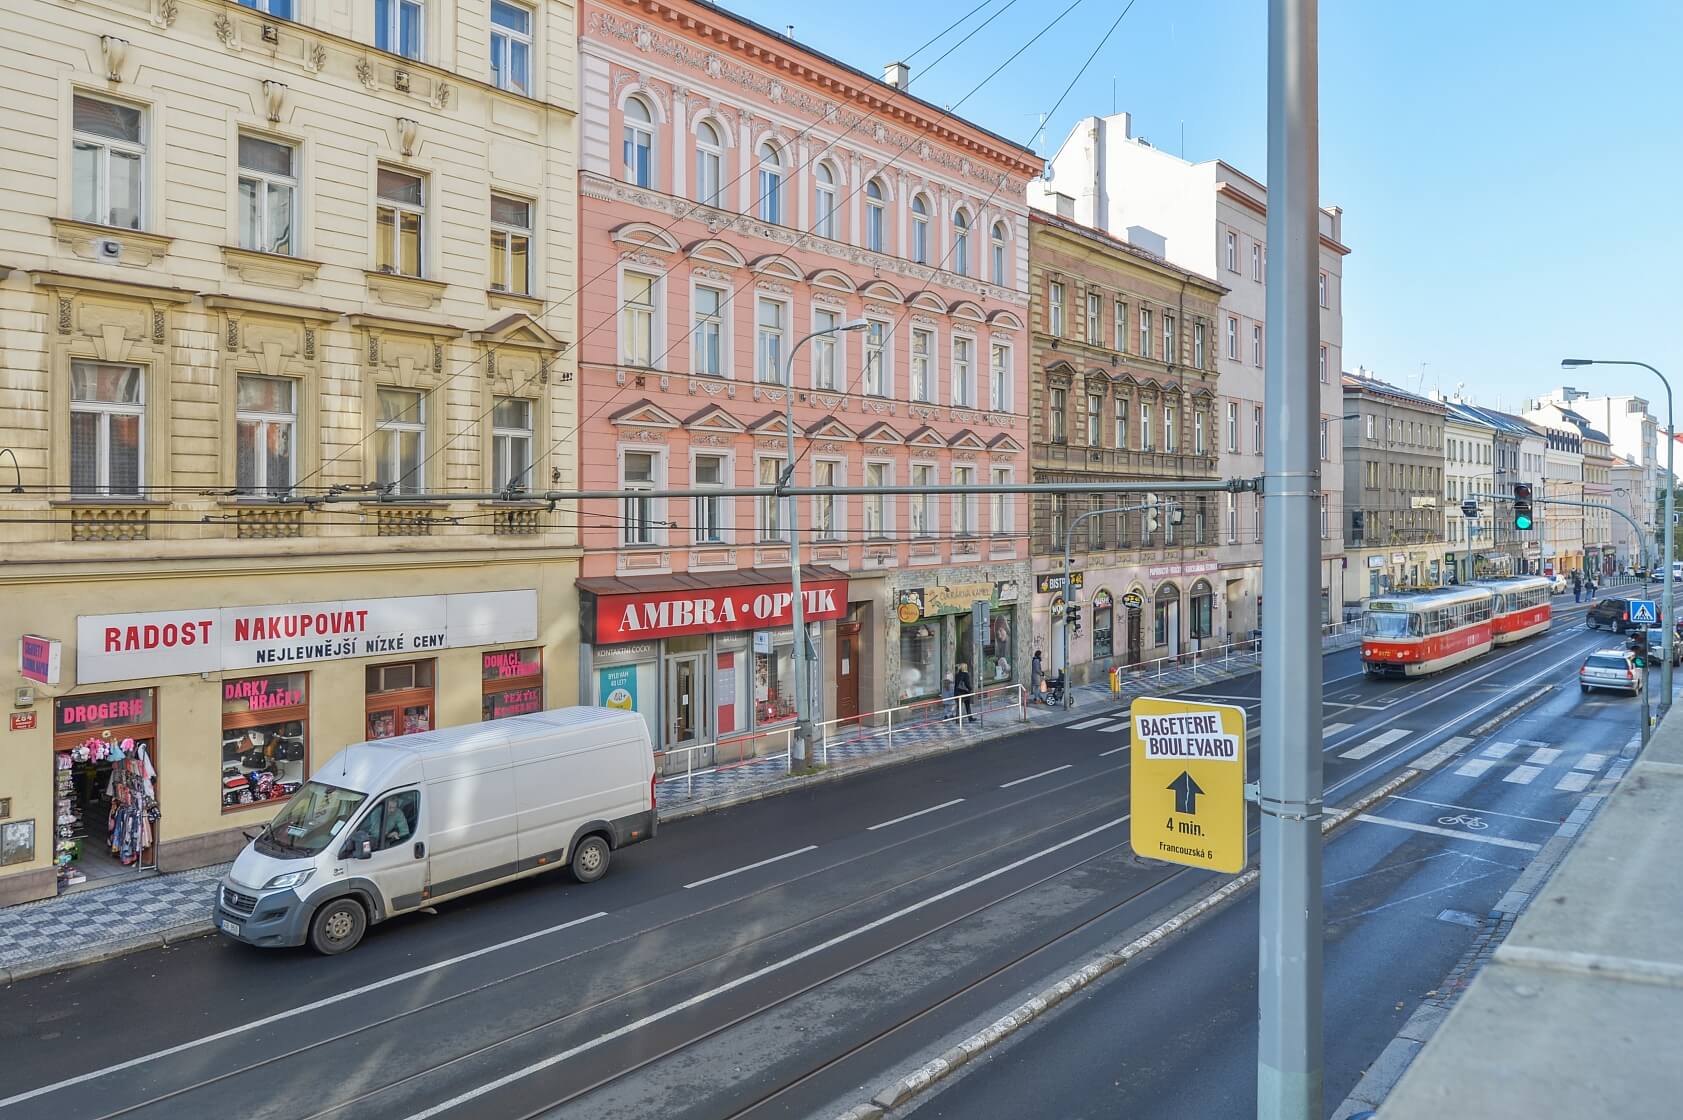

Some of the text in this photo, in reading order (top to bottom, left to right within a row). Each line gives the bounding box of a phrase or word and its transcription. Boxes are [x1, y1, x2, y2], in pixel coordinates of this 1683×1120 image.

[617, 597, 737, 632] AMBRA
[104, 610, 369, 652] RADOST NAKUPOVAT
[256, 632, 445, 663] NEJLEVNĚJŠÍ NÍZKÉ CENY
[224, 679, 269, 700] DÁRKY
[249, 687, 303, 712] HRAČKY
[63, 698, 145, 724] DROGERIE
[1140, 715, 1219, 737] BAGETERIE
[1150, 738, 1235, 758] BOULEVARD
[1166, 817, 1206, 837] 4 min.
[1159, 841, 1213, 860] Francouzská 6
